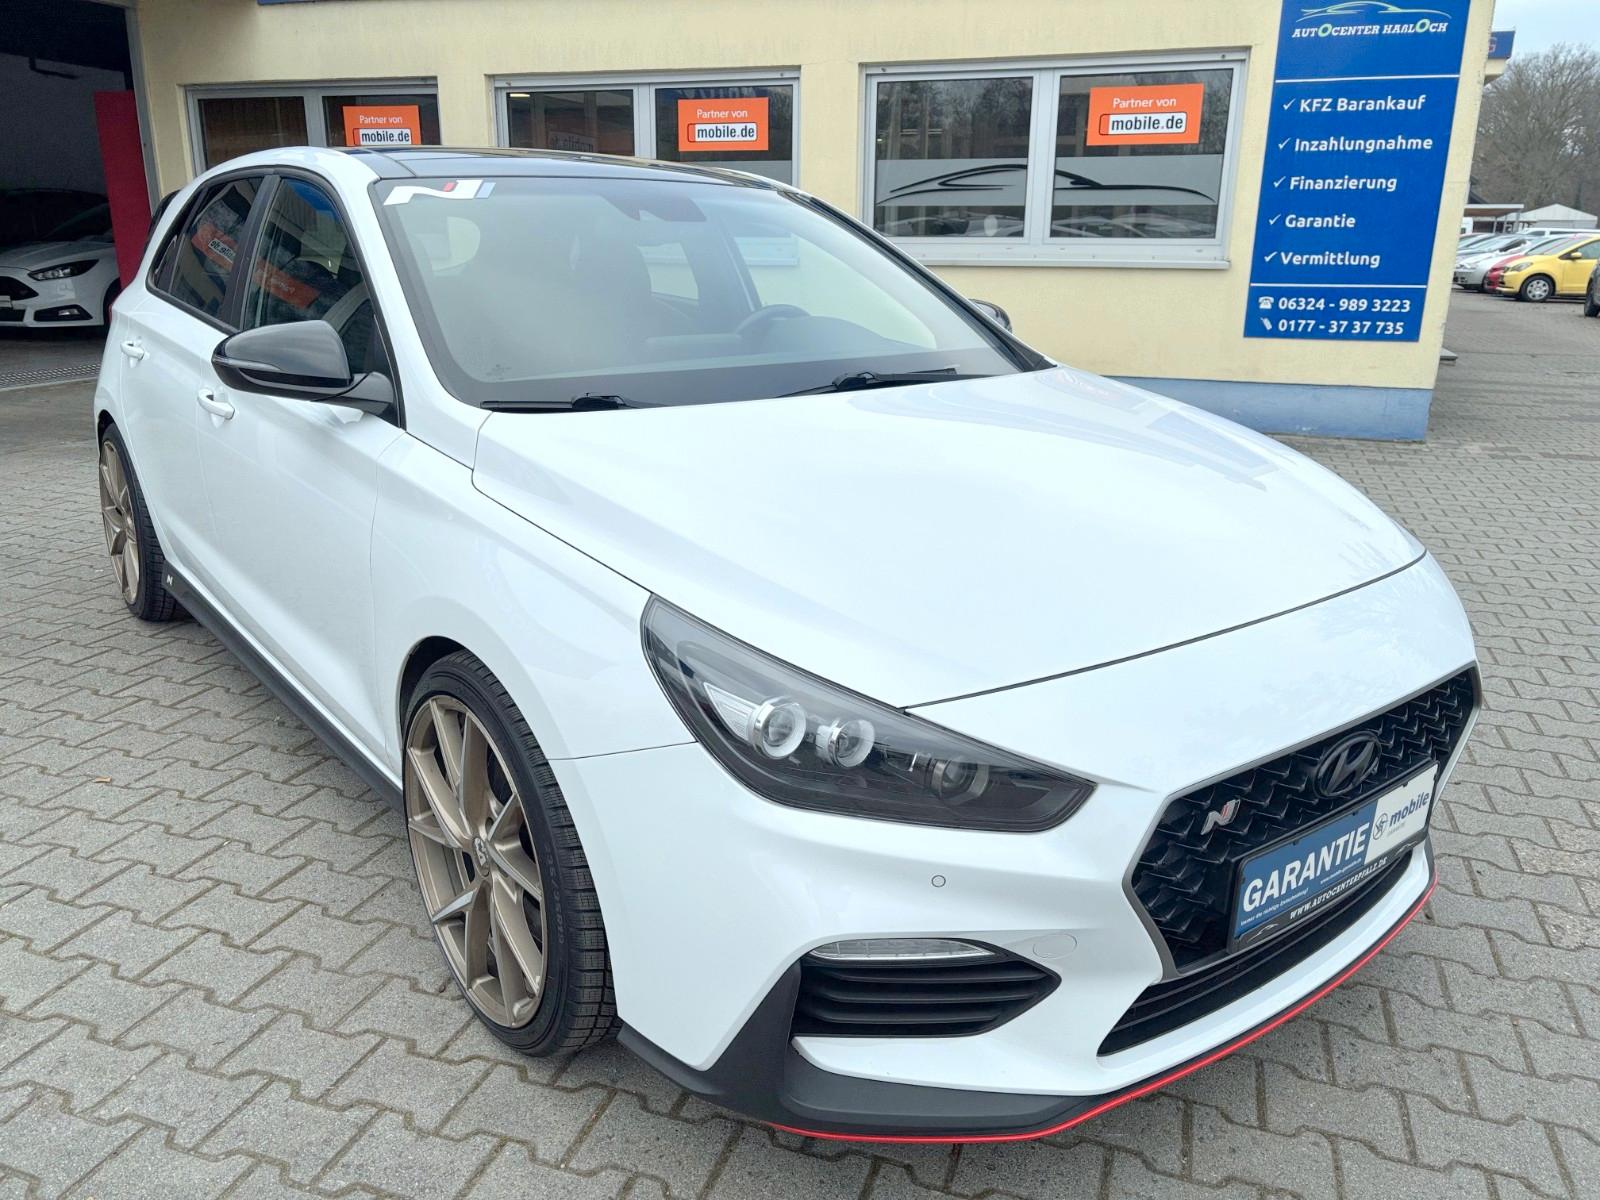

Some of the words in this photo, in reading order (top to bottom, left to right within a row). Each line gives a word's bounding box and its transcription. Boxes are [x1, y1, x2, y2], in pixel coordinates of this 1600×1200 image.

[1292, 24, 1380, 38] AUTOCENTER
[1113, 97, 1153, 109] Partner
[1156, 98, 1177, 107] von
[1299, 98, 1333, 113] KFZ
[1336, 95, 1427, 112] Barankauf
[359, 115, 387, 124] Partner
[388, 116, 403, 124] von
[696, 109, 729, 119] Partner
[731, 110, 748, 118] von
[1111, 115, 1184, 131] mobile.de
[361, 131, 410, 143] mobile.de
[697, 125, 755, 139] mobile.de
[1294, 135, 1434, 154] Inzahlungnahme
[1289, 175, 1398, 192] Finanzierung
[1285, 214, 1357, 229] Garantie
[1280, 251, 1381, 269] Vermittlung
[1278, 297, 1325, 311] 06324
[1339, 298, 1368, 312] 989
[1371, 299, 1411, 313] 3223
[1278, 319, 1316, 332] 0177
[1328, 320, 1348, 333] 37
[1352, 321, 1371, 334] 37
[1375, 322, 1405, 335] 735
[1243, 822, 1370, 912] GARANTIE
[1389, 792, 1430, 827] mobile
